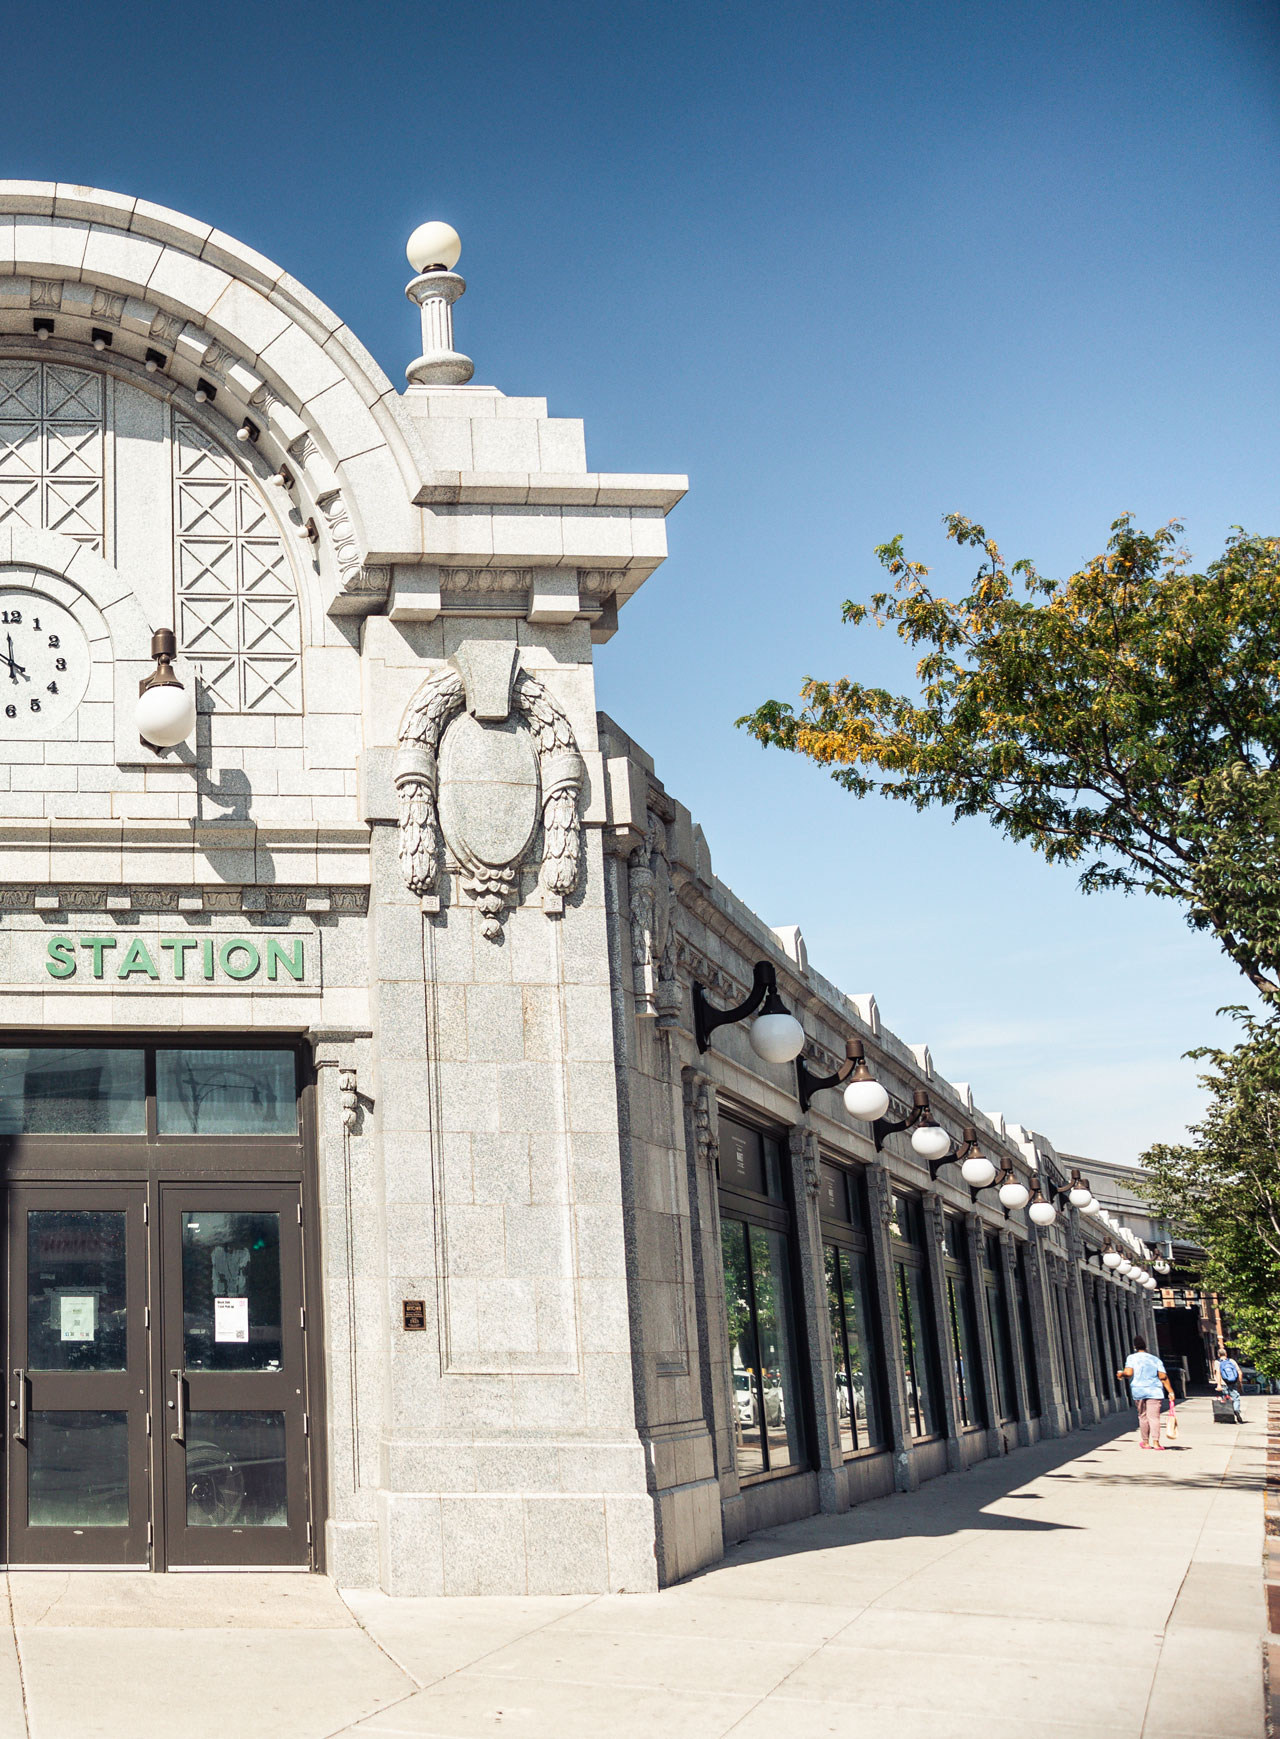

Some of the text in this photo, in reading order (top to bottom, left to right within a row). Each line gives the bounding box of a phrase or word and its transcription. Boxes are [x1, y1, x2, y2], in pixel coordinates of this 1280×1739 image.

[1, 610, 23, 624] 12
[32, 617, 43, 632] 1
[48, 634, 61, 649] 2
[55, 657, 68, 672] 3
[46, 680, 60, 695] 4
[5, 704, 18, 719] 6
[30, 698, 42, 713] 5
[45, 936, 304, 982] STATION
